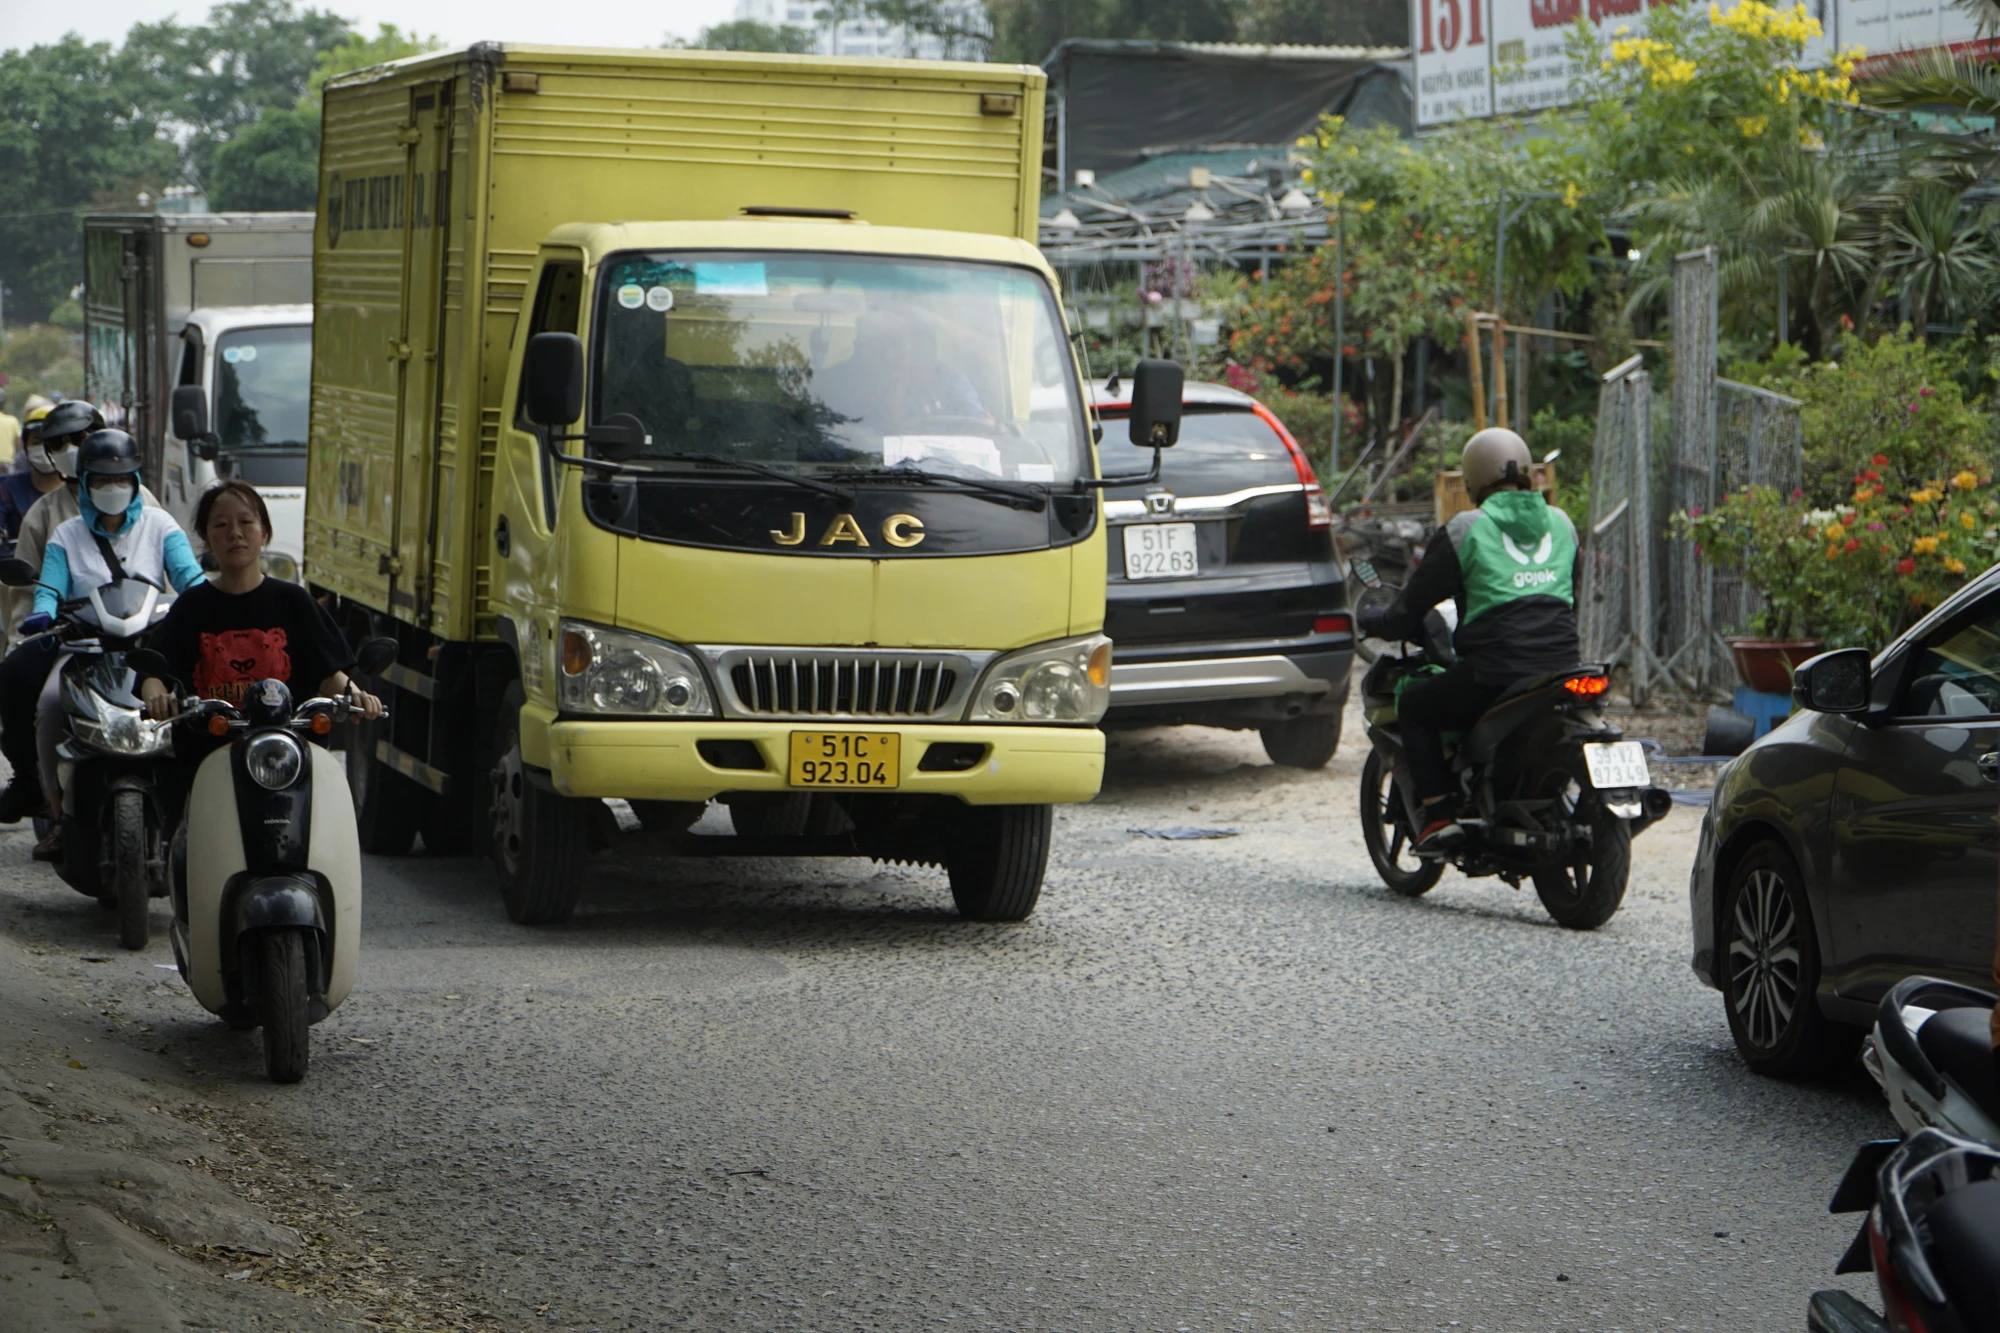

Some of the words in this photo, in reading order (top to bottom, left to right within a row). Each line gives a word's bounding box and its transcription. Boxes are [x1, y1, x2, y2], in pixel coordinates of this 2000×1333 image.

[769, 511, 926, 548] JAC
[1142, 528, 1178, 551] 51F
[1513, 569, 1558, 588] gojek
[822, 735, 868, 757] 51C
[802, 761, 887, 784] 923.04
